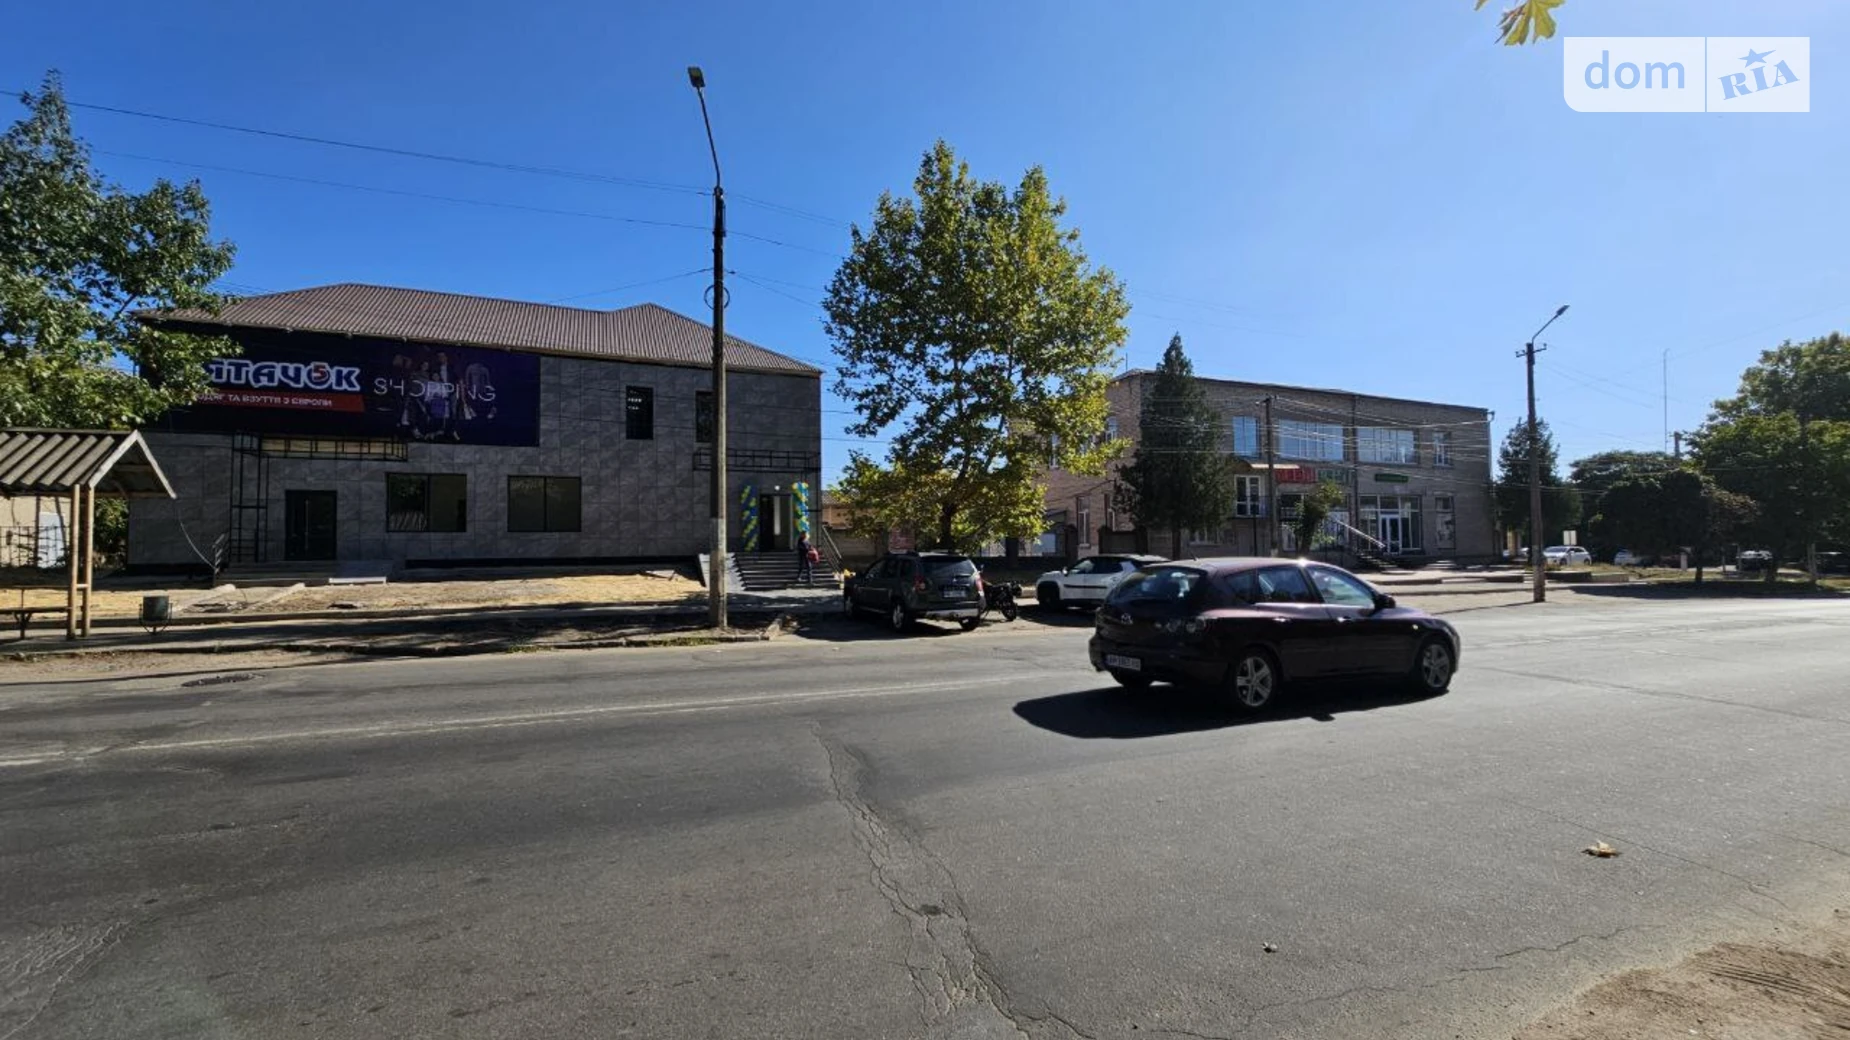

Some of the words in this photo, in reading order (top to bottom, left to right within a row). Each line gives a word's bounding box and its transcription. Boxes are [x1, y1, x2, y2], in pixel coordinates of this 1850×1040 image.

[204, 358, 362, 392] ЯТАЧОК
[228, 394, 241, 402] ТА
[373, 377, 497, 402] SHOPPING
